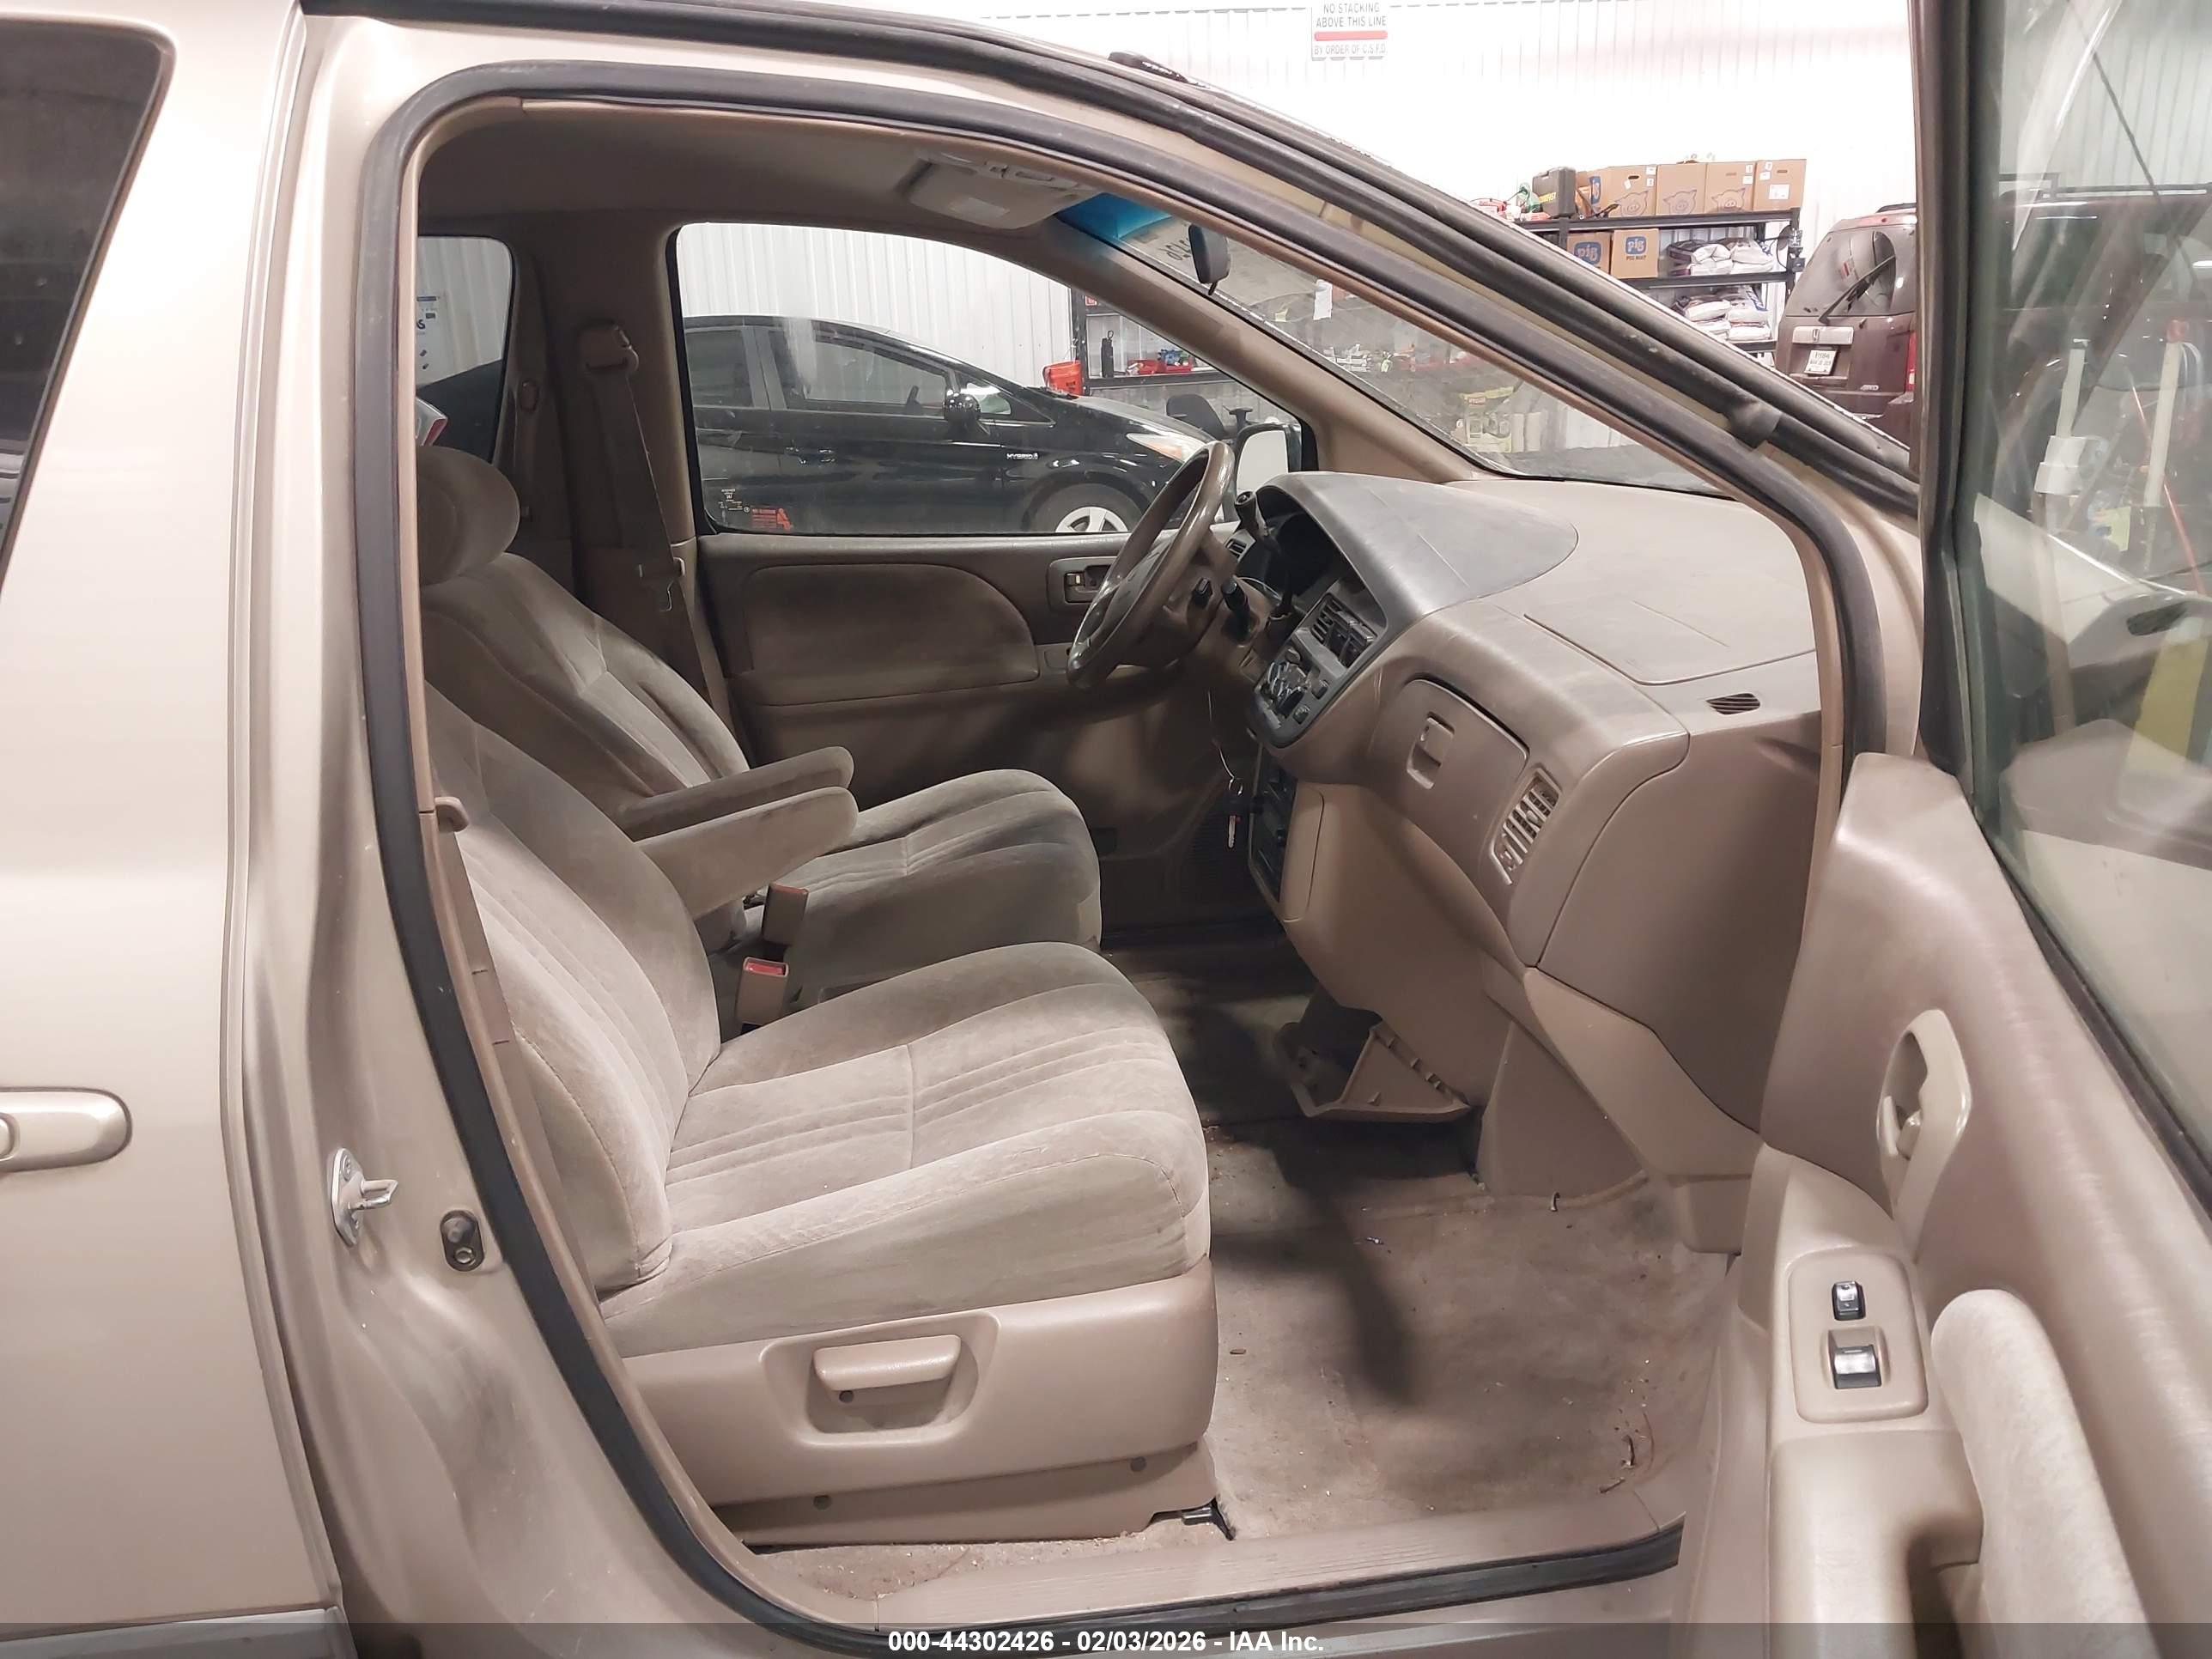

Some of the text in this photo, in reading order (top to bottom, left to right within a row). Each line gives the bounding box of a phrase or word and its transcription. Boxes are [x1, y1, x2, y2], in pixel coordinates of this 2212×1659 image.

[1323, 3, 1380, 14] NO STACKING
[1316, 15, 1387, 27] ABOVE THIS LINE
[1314, 46, 1322, 55] BY
[1326, 45, 1349, 55] ORDER
[1352, 44, 1359, 54] OF
[1627, 238, 1644, 252] pig
